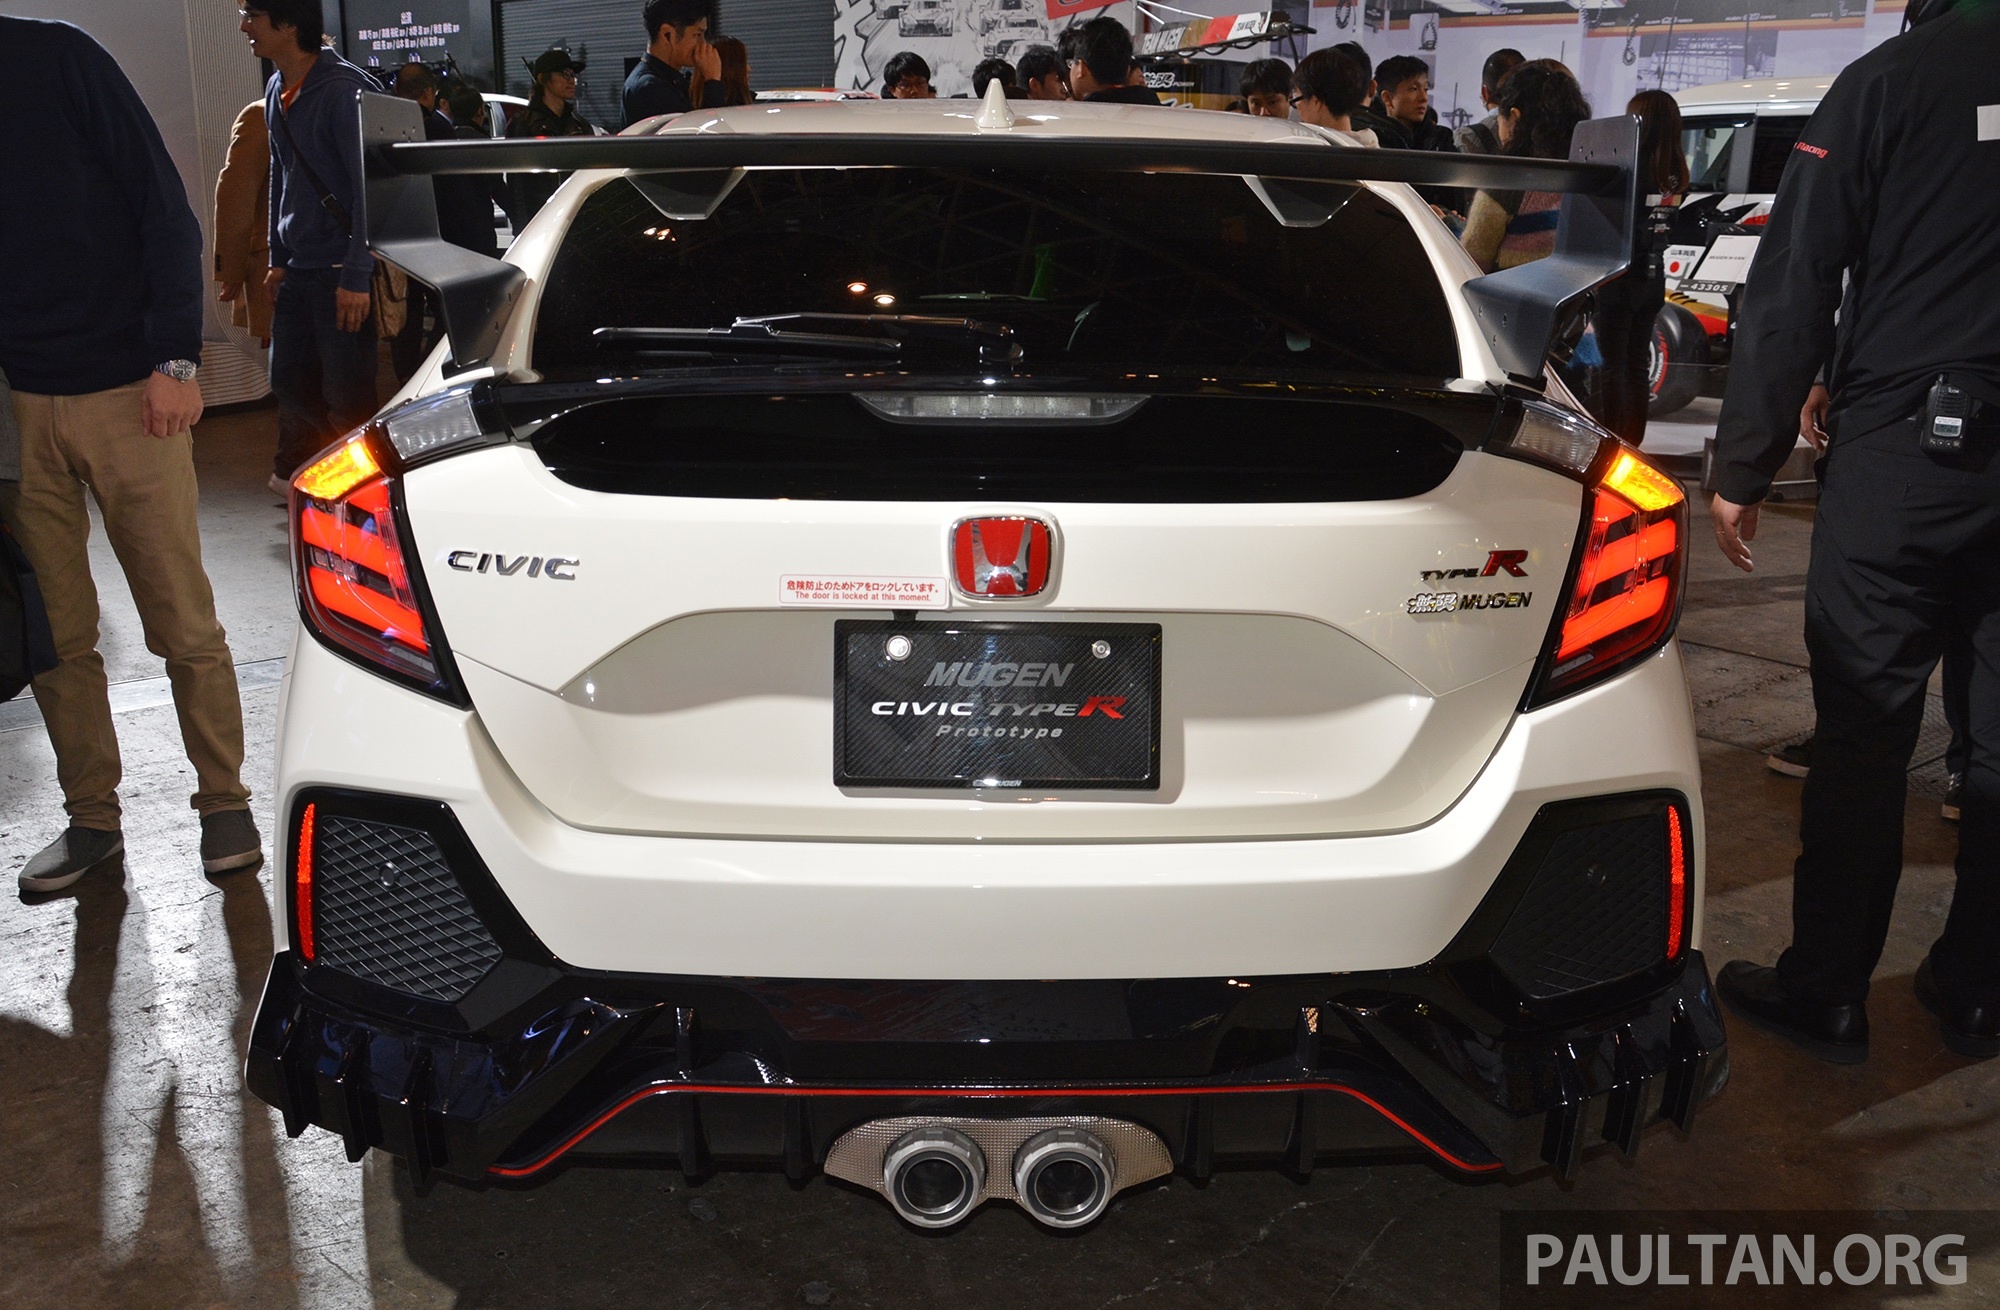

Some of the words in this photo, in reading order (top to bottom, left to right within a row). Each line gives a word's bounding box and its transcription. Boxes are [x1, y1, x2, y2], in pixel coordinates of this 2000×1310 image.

[1796, 141, 1829, 159] Racing
[1690, 283, 1729, 292] 43305
[447, 550, 580, 581] CIVIC
[1420, 568, 1480, 581] TYPE
[1480, 549, 1529, 577] R
[786, 579, 939, 593] 危険防止のためドアをロックしています。
[795, 591, 810, 599] The
[812, 591, 830, 599] door
[833, 591, 840, 600] is
[842, 591, 869, 600] locked
[881, 592, 896, 601] this
[1459, 592, 1533, 611] MUGEN
[924, 662, 1075, 687] MUGEN
[871, 701, 975, 716] CIVIC
[989, 703, 1078, 717] TYPE
[1077, 696, 1127, 719] R
[936, 724, 1063, 739] Prototype
